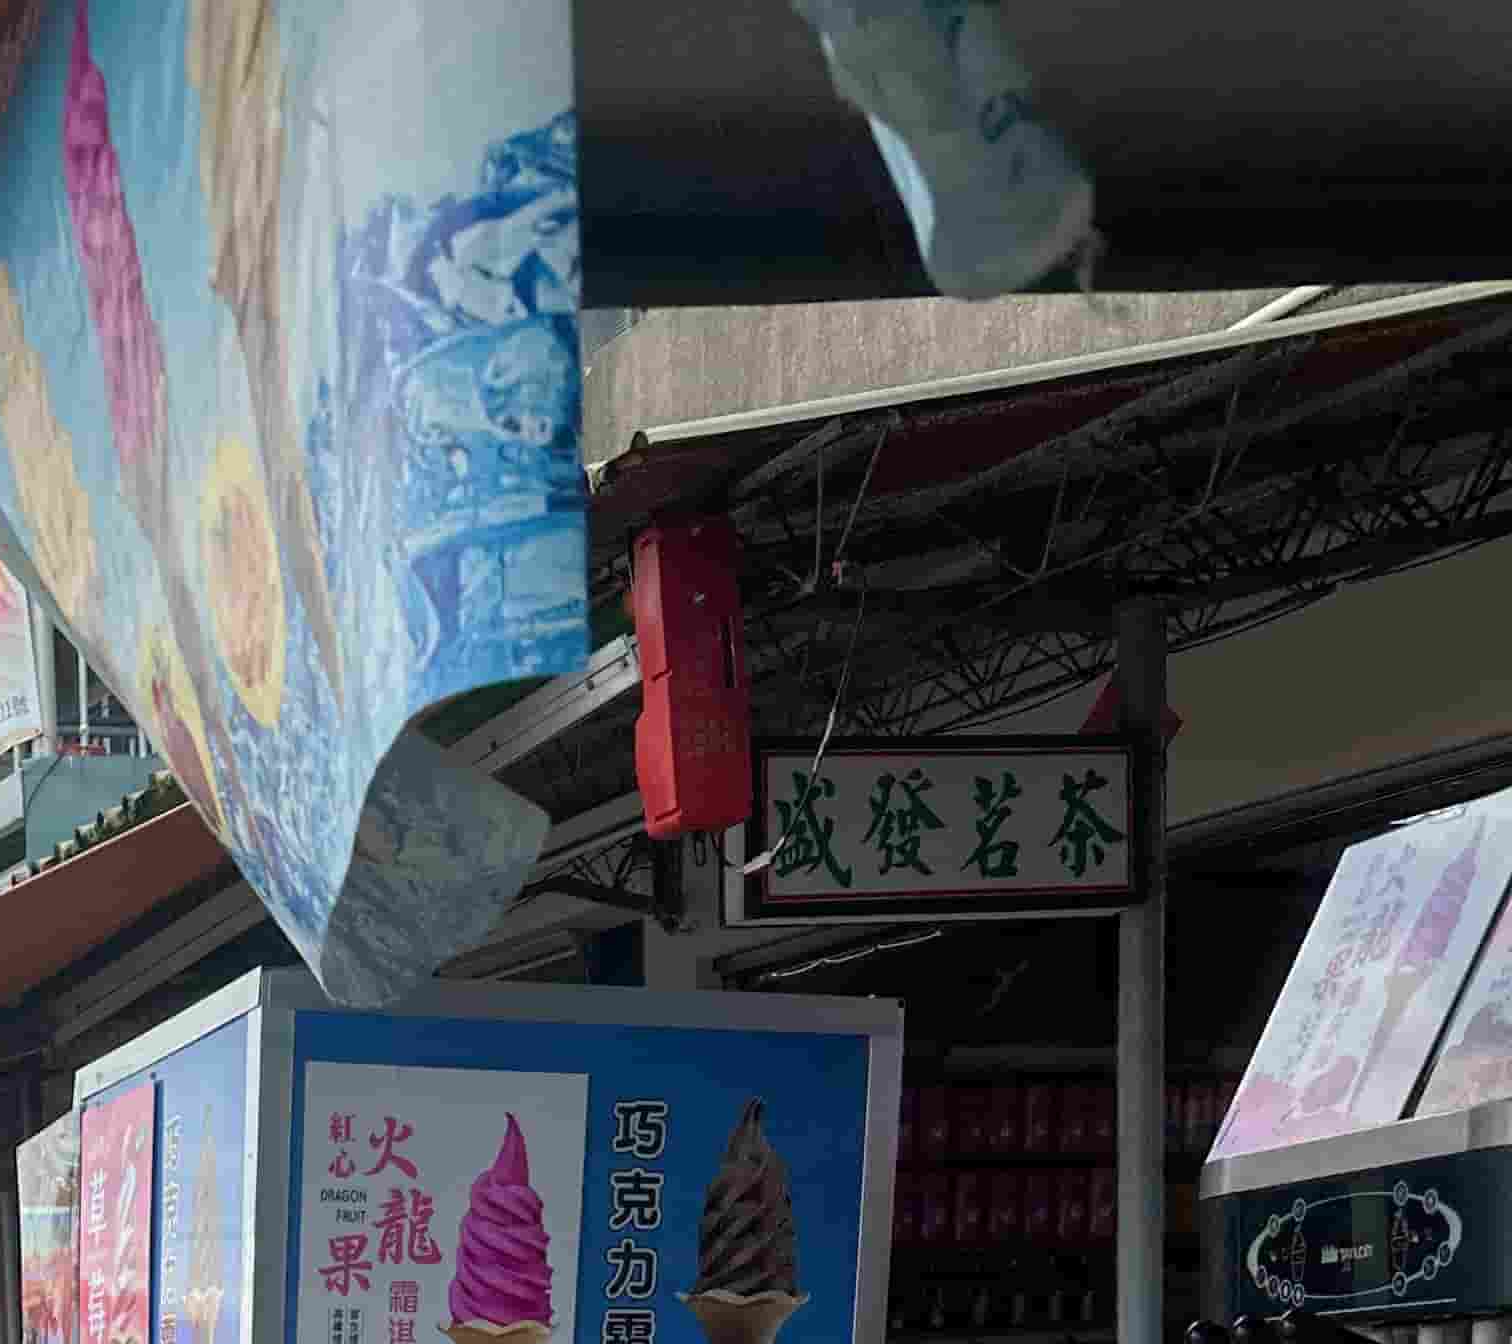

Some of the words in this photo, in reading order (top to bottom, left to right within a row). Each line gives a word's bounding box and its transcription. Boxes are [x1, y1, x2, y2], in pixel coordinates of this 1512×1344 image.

[768, 769, 1126, 888] 盛發茗茶
[327, 1111, 357, 1180] 紅心
[320, 1187, 368, 1205] DRAGON
[335, 1209, 367, 1225] FRUIT
